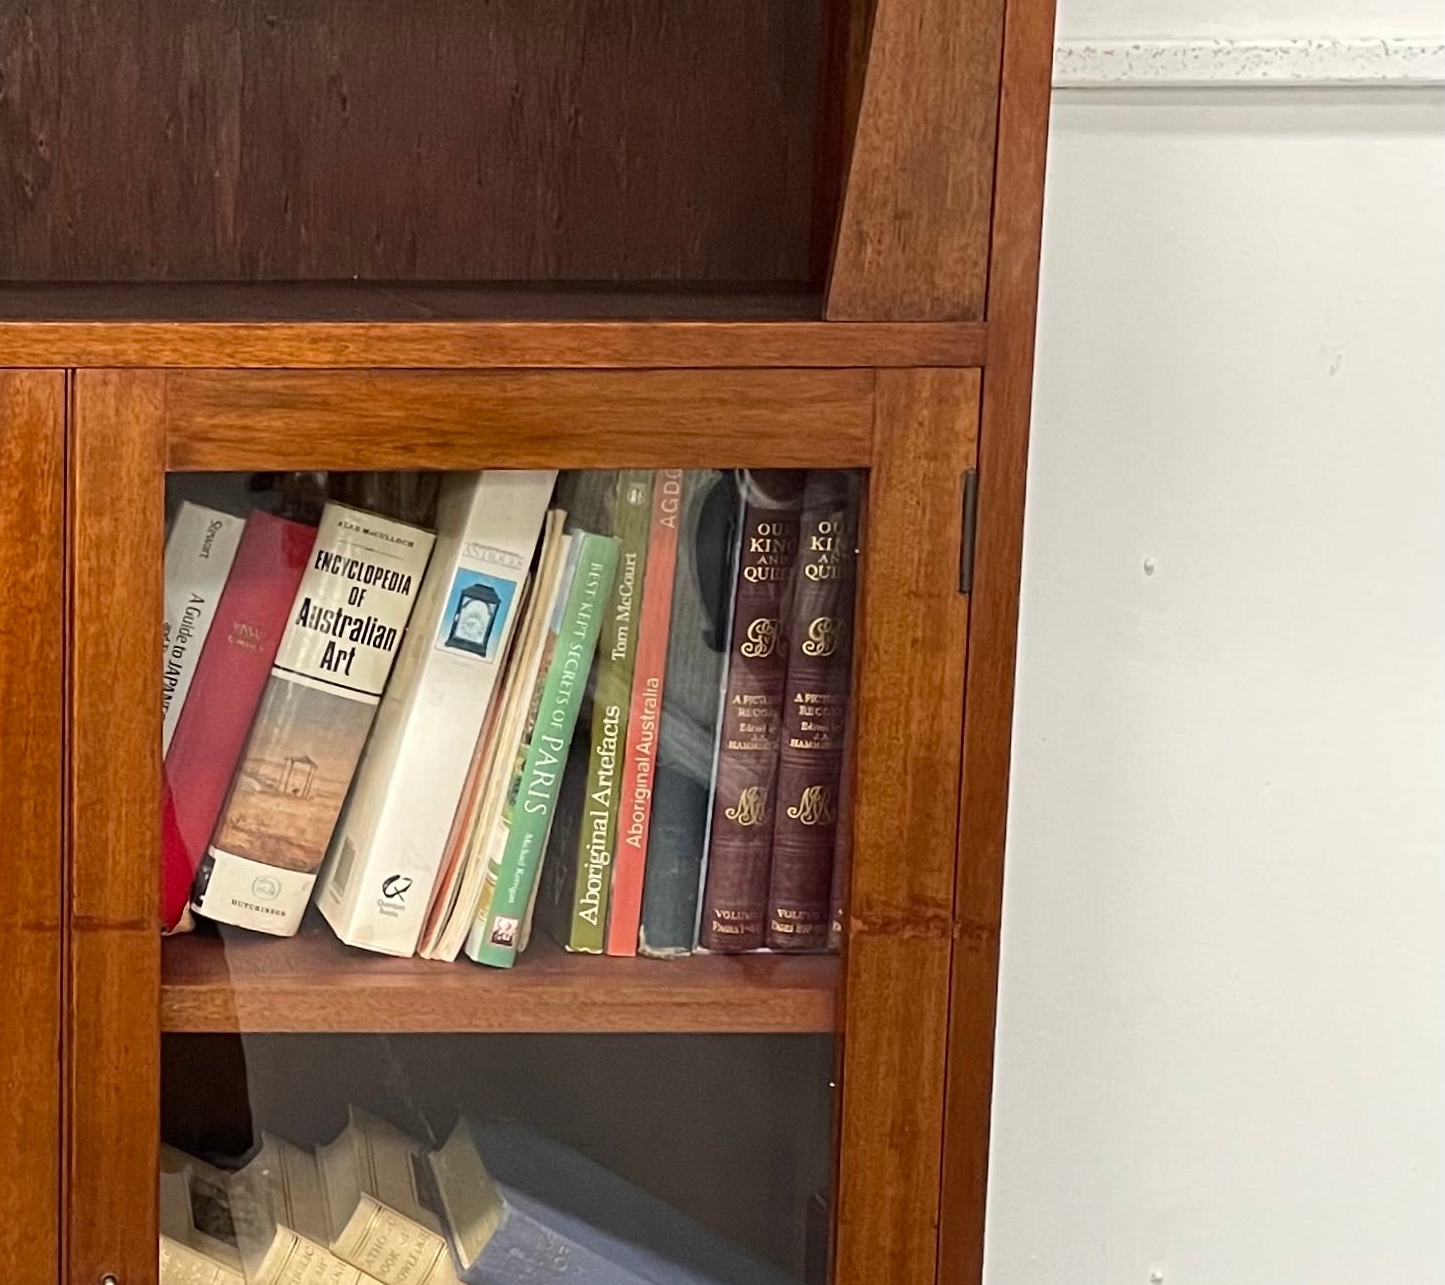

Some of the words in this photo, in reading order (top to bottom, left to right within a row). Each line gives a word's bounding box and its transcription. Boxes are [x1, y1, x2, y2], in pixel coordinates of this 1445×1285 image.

[749, 537, 790, 553] KIN
[757, 523, 789, 536] OU
[818, 521, 844, 535] OU
[314, 549, 412, 596] ENCYCLOPEDIA
[615, 552, 637, 622] McCourt
[189, 592, 206, 604] A
[348, 585, 367, 608] OF
[176, 605, 201, 644] Guide
[295, 597, 398, 652] Australian
[171, 643, 187, 661] to
[319, 640, 356, 677] Art
[611, 631, 628, 661] Tom
[555, 642, 584, 706] SECRETS
[552, 709, 566, 731] OF
[635, 677, 660, 756] Australia
[523, 734, 564, 815] PARIS
[591, 705, 620, 807] Artefacts
[625, 756, 652, 848] Aboriginal
[516, 833, 534, 864] Michael
[578, 809, 612, 926] Aboriginal
[231, 898, 286, 917] HUTCHINSON
